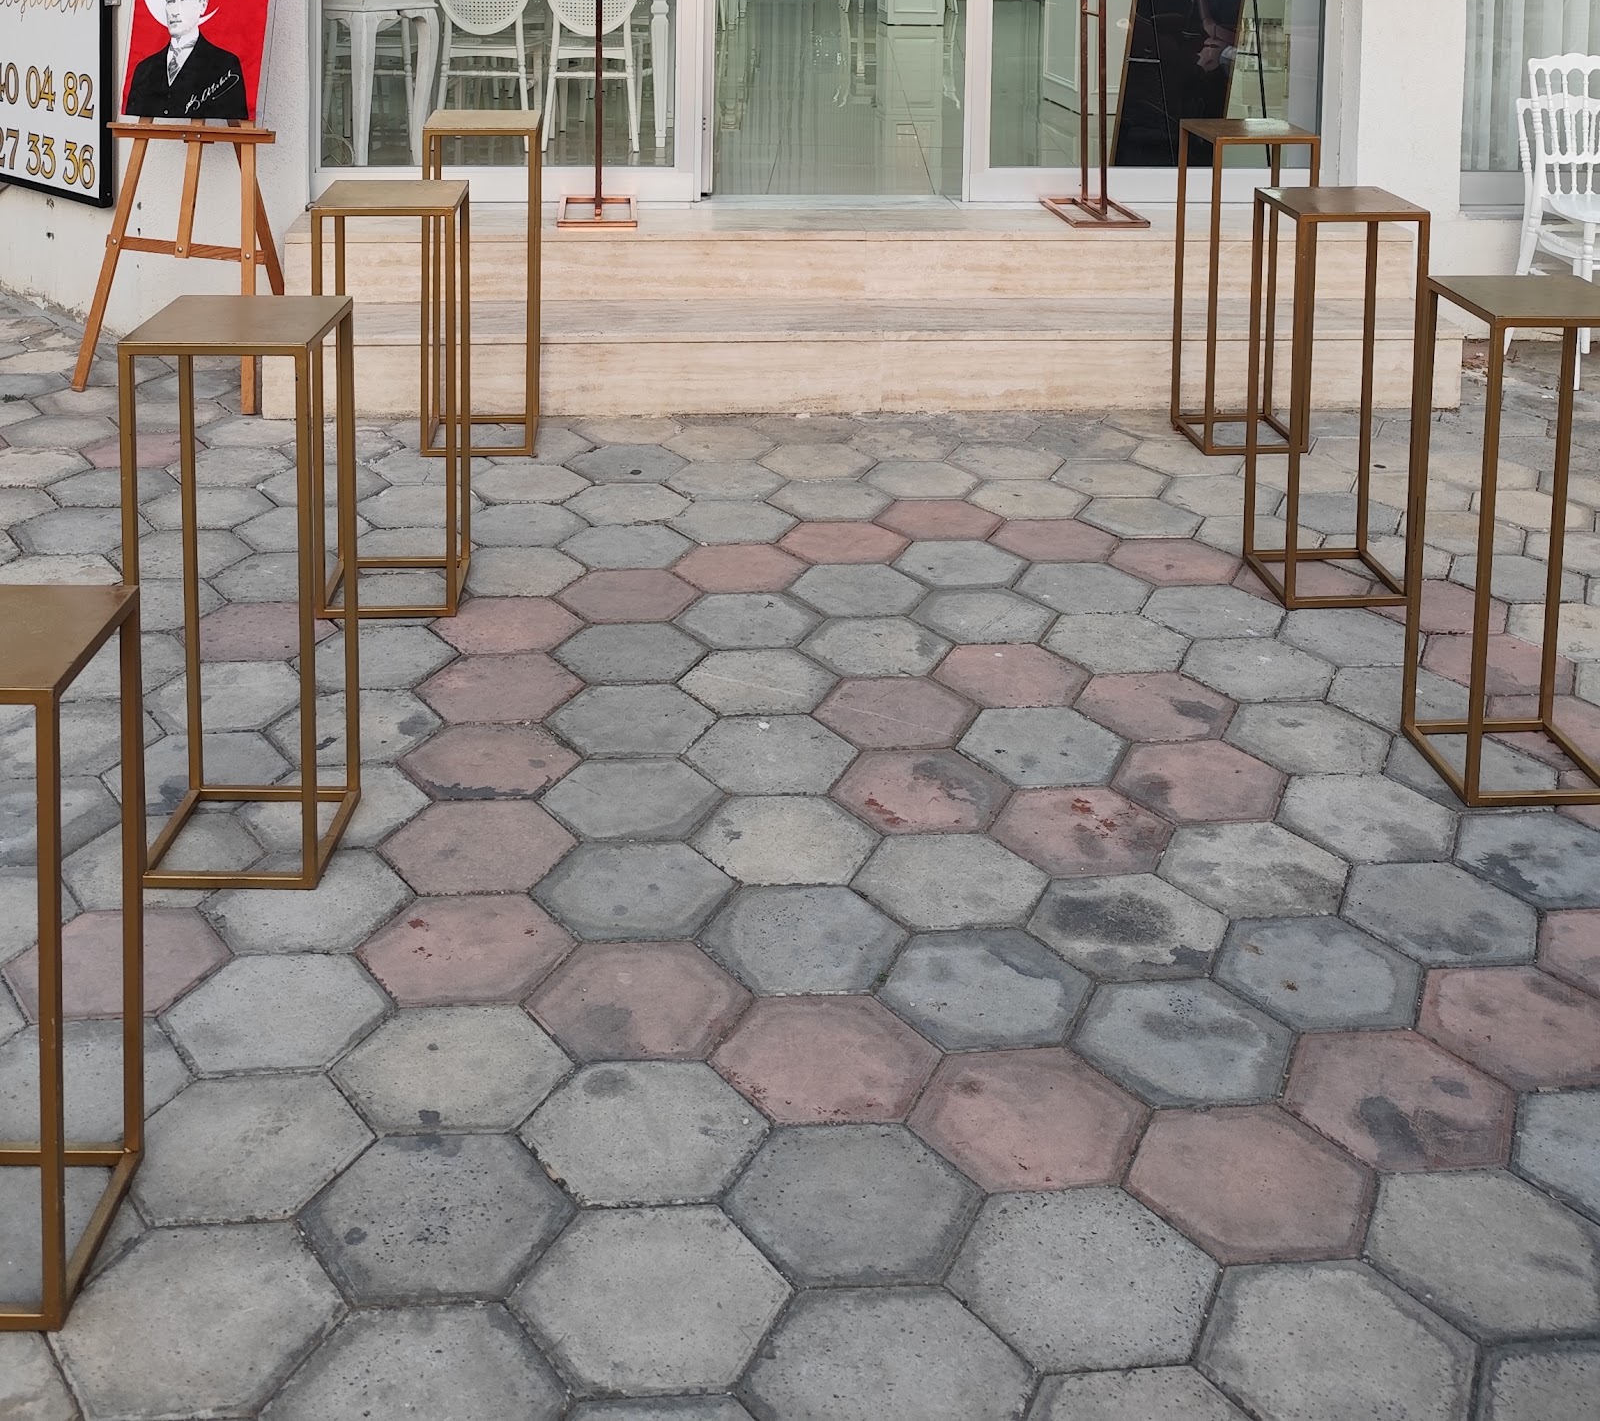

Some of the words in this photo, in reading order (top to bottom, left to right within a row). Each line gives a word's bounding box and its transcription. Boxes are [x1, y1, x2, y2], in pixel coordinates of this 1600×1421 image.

[25, 65, 56, 112] 04
[62, 71, 95, 120] 82
[25, 130, 57, 180] 33
[62, 138, 96, 190] 36
